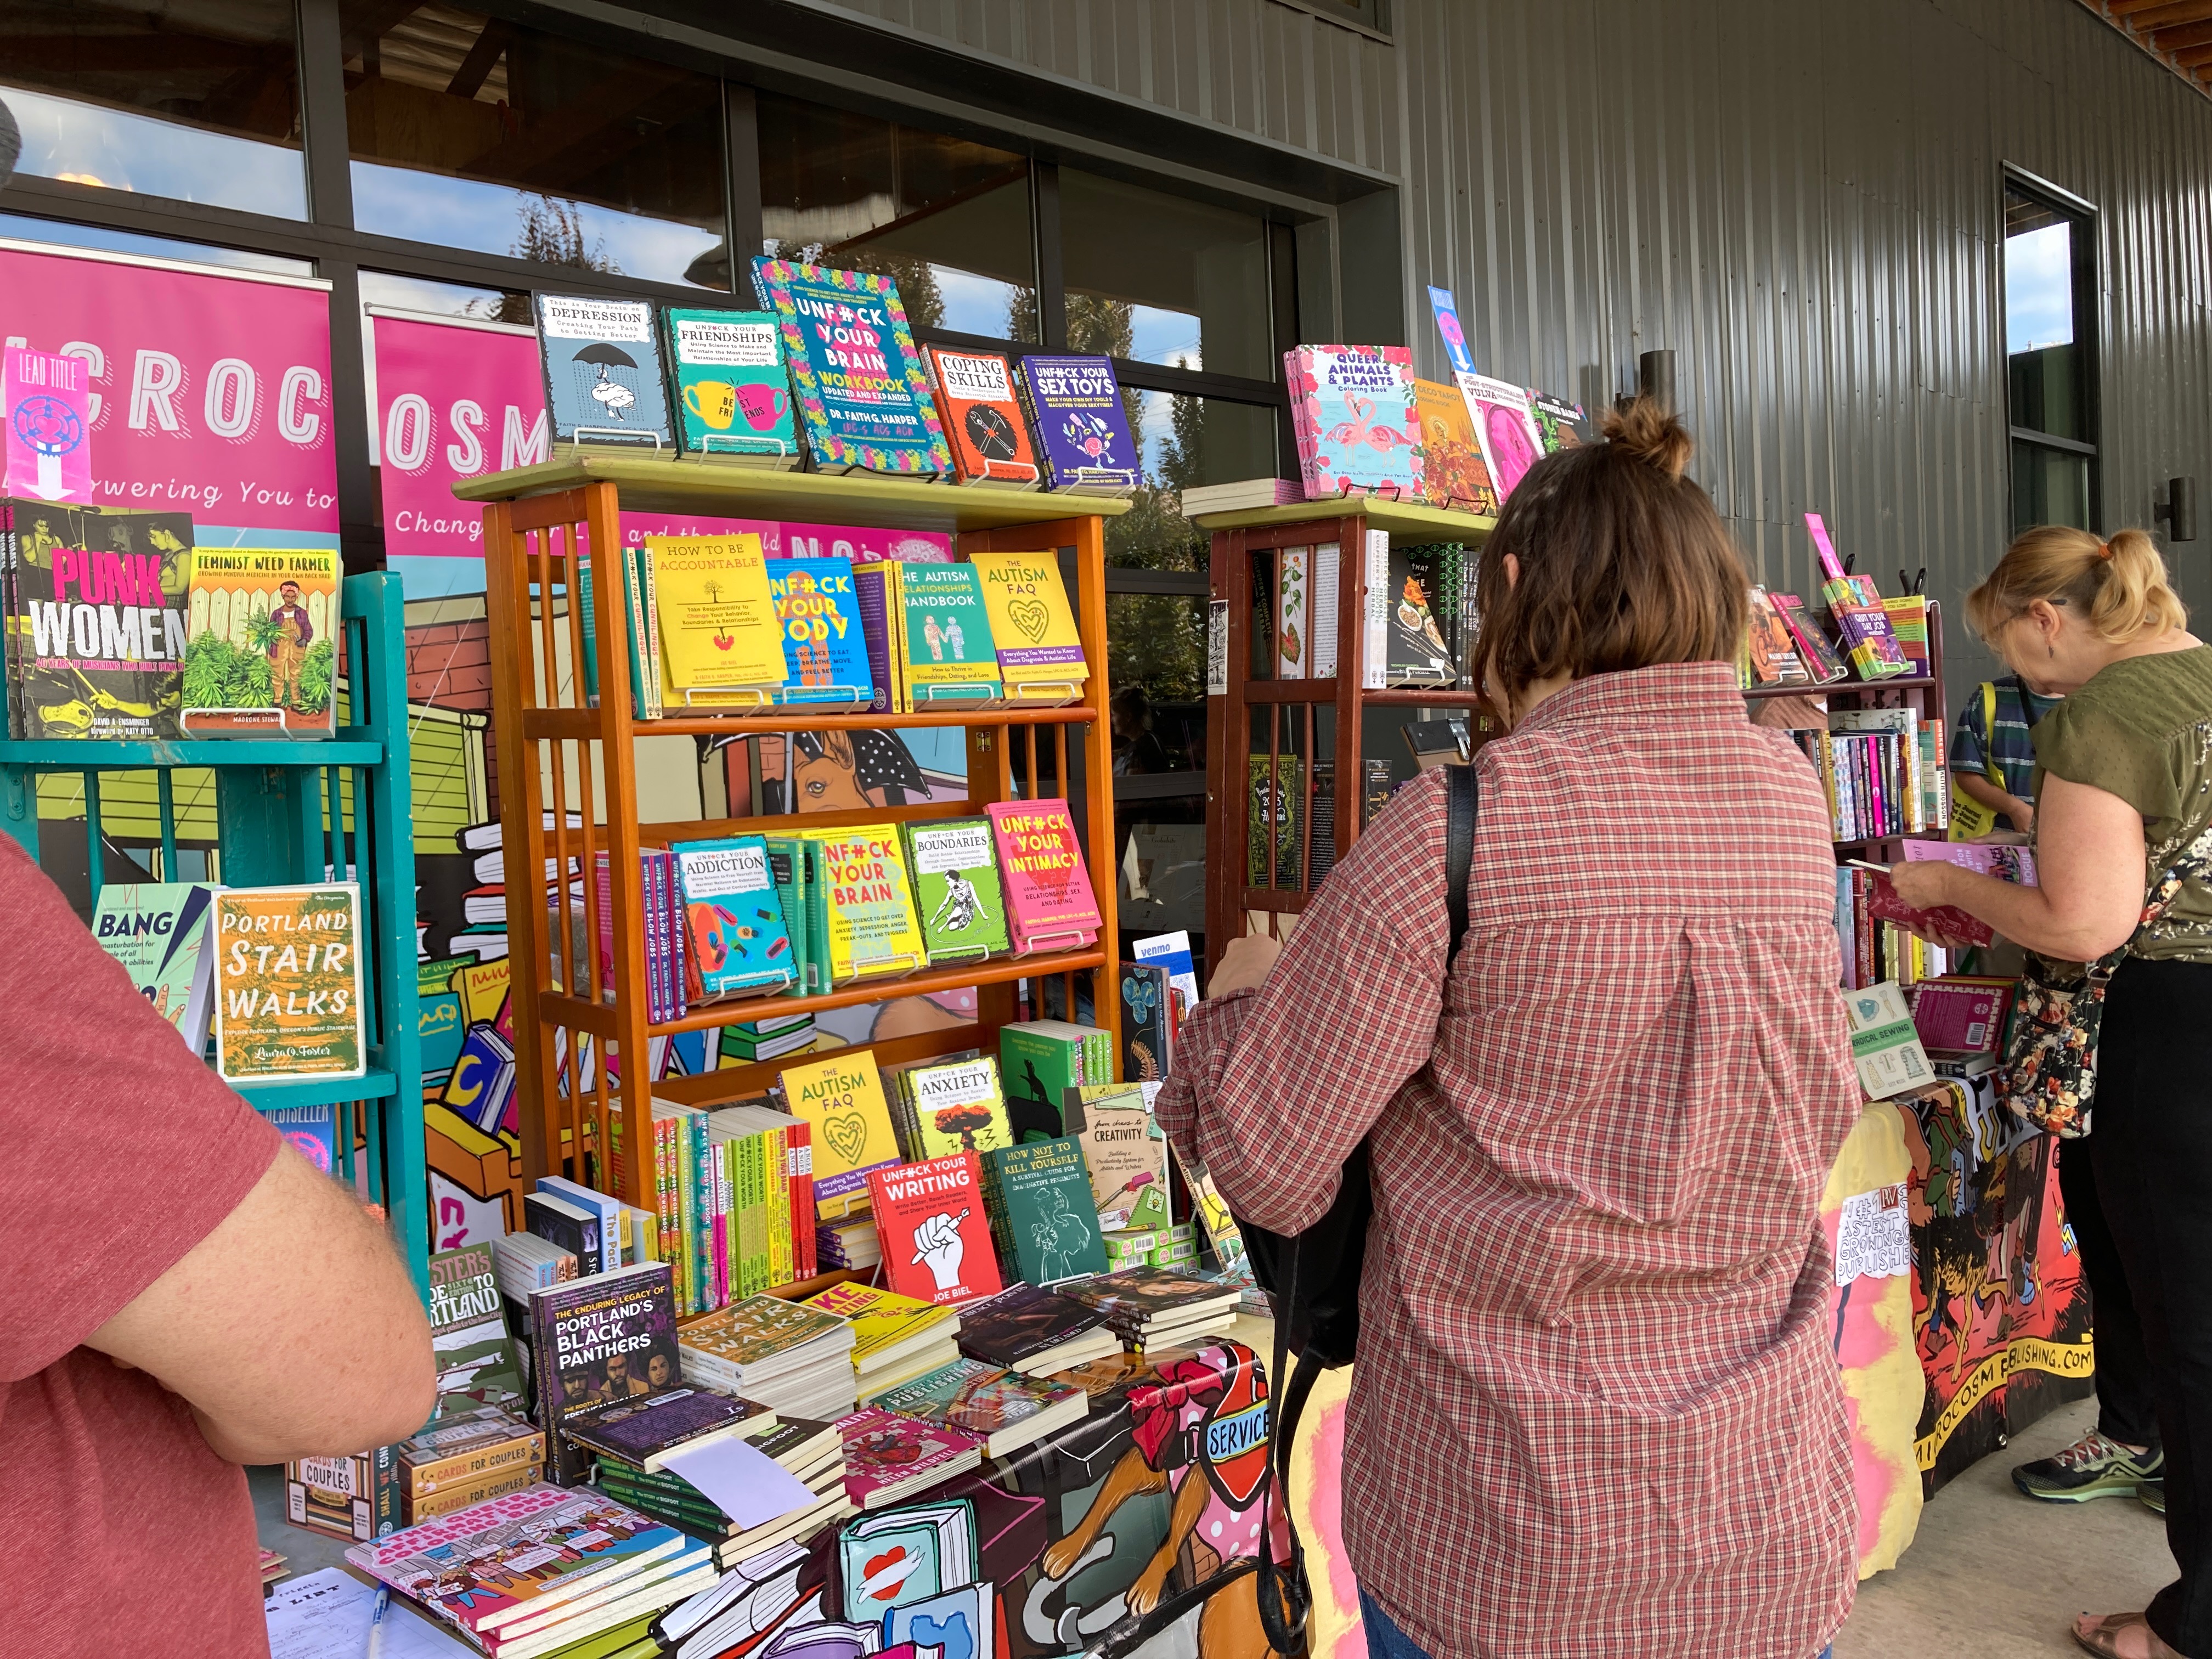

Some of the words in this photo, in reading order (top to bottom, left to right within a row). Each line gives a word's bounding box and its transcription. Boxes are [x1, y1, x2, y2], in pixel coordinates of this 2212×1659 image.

[550, 307, 641, 323] DEPRESSION
[795, 297, 887, 326] UNF#CK
[556, 320, 593, 330] Creating
[574, 329, 605, 338] Getting
[681, 330, 772, 343] FRIENDSHIPS
[818, 324, 878, 348] YOUR
[825, 348, 888, 371] BRAIN
[942, 356, 1002, 375] COPING
[1336, 354, 1379, 364] QUEER
[19, 353, 46, 386] LEAD
[49, 358, 78, 391] TITLE
[1035, 368, 1079, 378] UNF#CK
[1082, 368, 1109, 377] YOUR
[1328, 364, 1391, 375] ANIMALS
[817, 370, 907, 392] WORKBOOK
[949, 372, 1006, 389] SKILLS
[1039, 379, 1071, 394] SEX
[1073, 379, 1115, 394] TOYS
[1328, 374, 1339, 385] &
[1342, 376, 1395, 386] PLANTS
[822, 386, 855, 398] UPDATED
[856, 390, 871, 399] AND
[872, 391, 911, 402] EXPANDED
[1438, 390, 1461, 402] TAROT
[1468, 387, 1498, 399] VULVA
[830, 409, 845, 420] DR.
[845, 411, 871, 422] FAITH
[872, 414, 882, 424] G.
[882, 414, 919, 425] HARPER
[240, 480, 293, 505] You
[306, 484, 335, 509] to
[668, 546, 702, 556] HOW
[706, 545, 723, 555] TO
[729, 544, 744, 554] BE
[198, 555, 250, 569] FEMINIST
[256, 556, 284, 571] WEED
[290, 557, 331, 572] FARMER
[659, 557, 759, 570] ACCOUNTABLE
[52, 548, 166, 607] PUNK
[925, 572, 970, 582] AUTISM
[988, 568, 1048, 583] AUTISM
[1007, 584, 1037, 596] FAQ
[778, 599, 838, 617] YOUR
[905, 595, 976, 606] HANDBOOK
[1854, 613, 1867, 623] QUIT
[1869, 612, 1886, 622] YOUR
[1875, 622, 1886, 630] JOB
[28, 600, 188, 661] WOMEN
[93, 718, 110, 726] DAVID
[112, 718, 117, 726] A.
[119, 718, 150, 726] ENSMINGER
[1000, 813, 1070, 834] UNF#CK
[917, 835, 987, 851] BOUNDARIES
[1017, 833, 1063, 852] YOUR
[686, 856, 764, 875] ADDICTION
[829, 863, 885, 882] YOUR
[1008, 851, 1079, 874] INTIMACY
[2022, 853, 2034, 883] ROGUE
[834, 883, 893, 906] BRAIN
[97, 911, 174, 938] BANG
[221, 912, 348, 934] PORTLAND
[226, 940, 348, 977] STAIR
[1141, 943, 1171, 957] venmo
[227, 988, 349, 1019] WALKS
[1852, 1034, 1878, 1048] RADICAL
[1879, 1024, 1910, 1039] SEWING
[822, 1068, 838, 1077] THE
[801, 1071, 866, 1103] AUTISM
[921, 1071, 990, 1096] ANXIETY
[822, 1094, 854, 1111] FAQ
[1094, 1128, 1142, 1142] CREATIVITY
[1007, 1150, 1029, 1161] HOW
[1033, 1147, 1054, 1159] NOT
[1056, 1142, 1071, 1152] TO
[882, 1164, 932, 1183] UNF#CK
[933, 1157, 967, 1172] YOUR
[1004, 1164, 1028, 1175] KILL
[1030, 1153, 1080, 1169] YOURSELF
[1018, 1171, 1043, 1181] SURVIVAL
[1044, 1169, 1062, 1177] GUIDE
[1063, 1166, 1076, 1174] FOR
[885, 1170, 970, 1201] WRITING
[1013, 1180, 1051, 1190] IMAGINATIVE
[1052, 1173, 1080, 1184] PESSIMISTS
[1840, 1230, 1904, 1260] GROWING
[555, 1310, 572, 1319] THE
[575, 1299, 617, 1315] ENDURING
[619, 1290, 651, 1304] LEGACY
[653, 1286, 666, 1295] OF
[933, 1290, 951, 1302] JOE
[951, 1285, 972, 1298] BIEL
[994, 1285, 1028, 1305] POINTS
[556, 1299, 653, 1335] PORTLAND'S
[678, 1300, 770, 1341] PORTLAND
[691, 1304, 787, 1346] STAIR
[557, 1321, 624, 1353] BLACK
[709, 1310, 808, 1353] WALKS
[559, 1333, 651, 1370] PANTHERS
[889, 1363, 985, 1406] PUBLISHING
[1209, 1408, 1269, 1457] SERVICE
[437, 1463, 467, 1481] CARDS
[471, 1459, 486, 1471] FOR
[490, 1447, 526, 1465] COUPLES
[877, 1469, 909, 1486] HELEN
[910, 1448, 958, 1472] WILDFELL
[307, 1465, 351, 1491] COUPLES
[381, 1470, 390, 1486] WE
[381, 1488, 390, 1517] SHALL
[379, 1491, 558, 1556] AFFIRMATIONS
[386, 1522, 435, 1543] THE
[446, 1494, 528, 1522] QUEER
[379, 1520, 499, 1565] COLORING
[509, 1493, 571, 1519] BOOK
